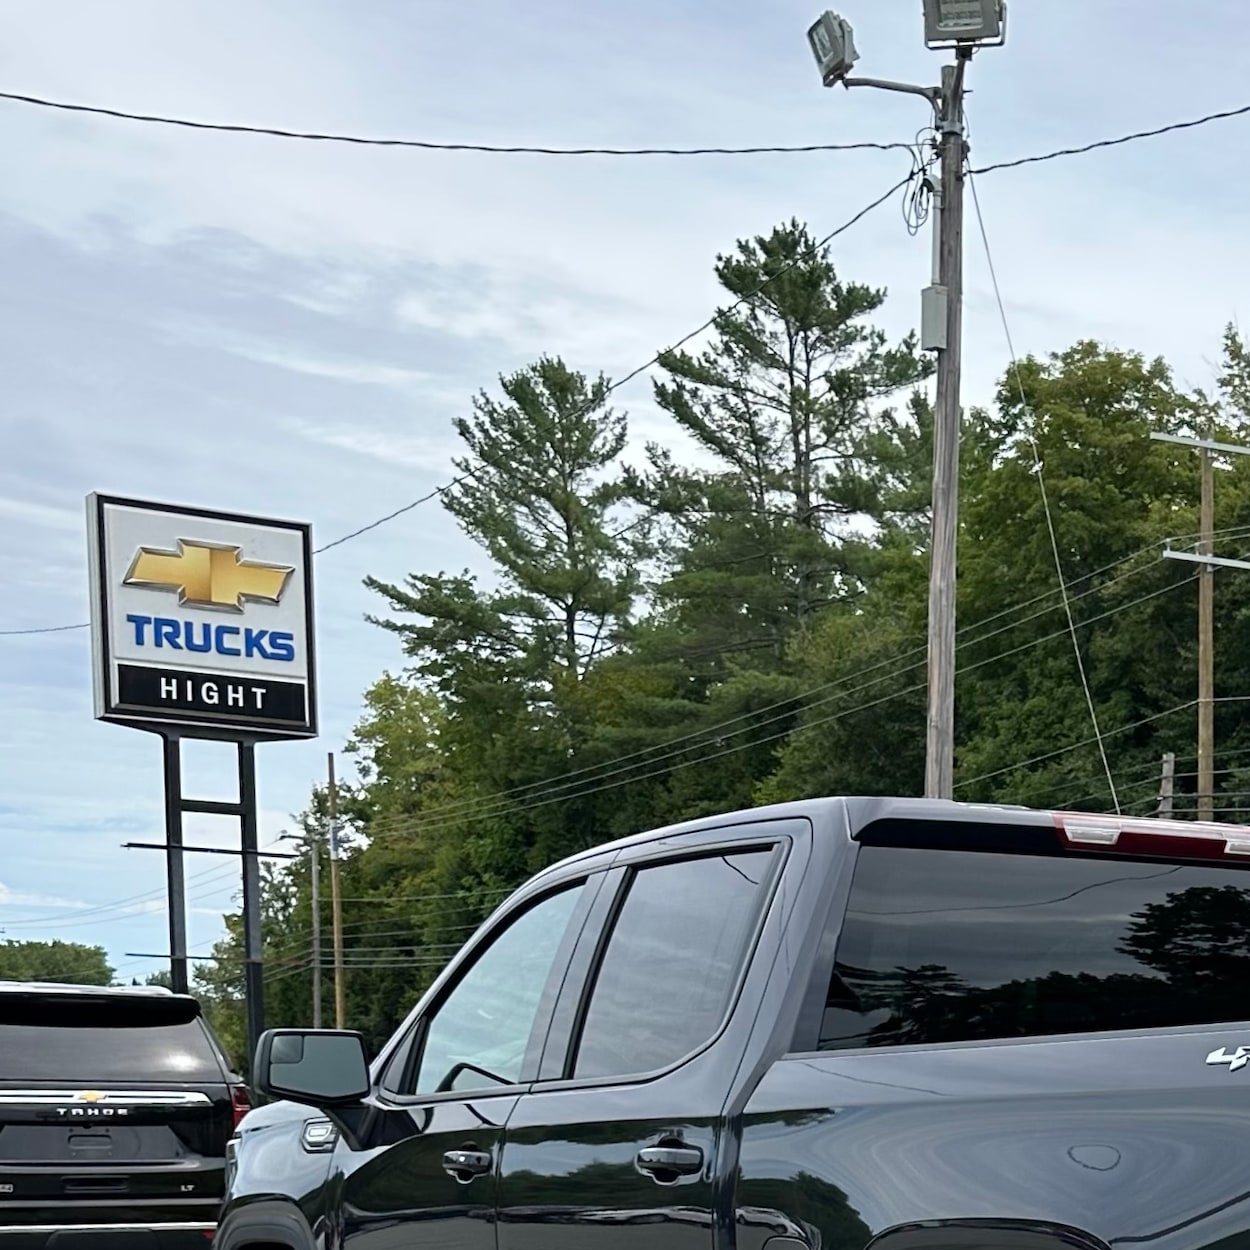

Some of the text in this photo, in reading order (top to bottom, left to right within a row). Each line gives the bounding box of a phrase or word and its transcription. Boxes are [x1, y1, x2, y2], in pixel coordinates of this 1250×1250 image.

[126, 614, 295, 662] TRUCKS
[160, 677, 267, 709] HIGHT
[56, 1108, 128, 1116] TAHOE
[180, 1184, 195, 1192] LT
